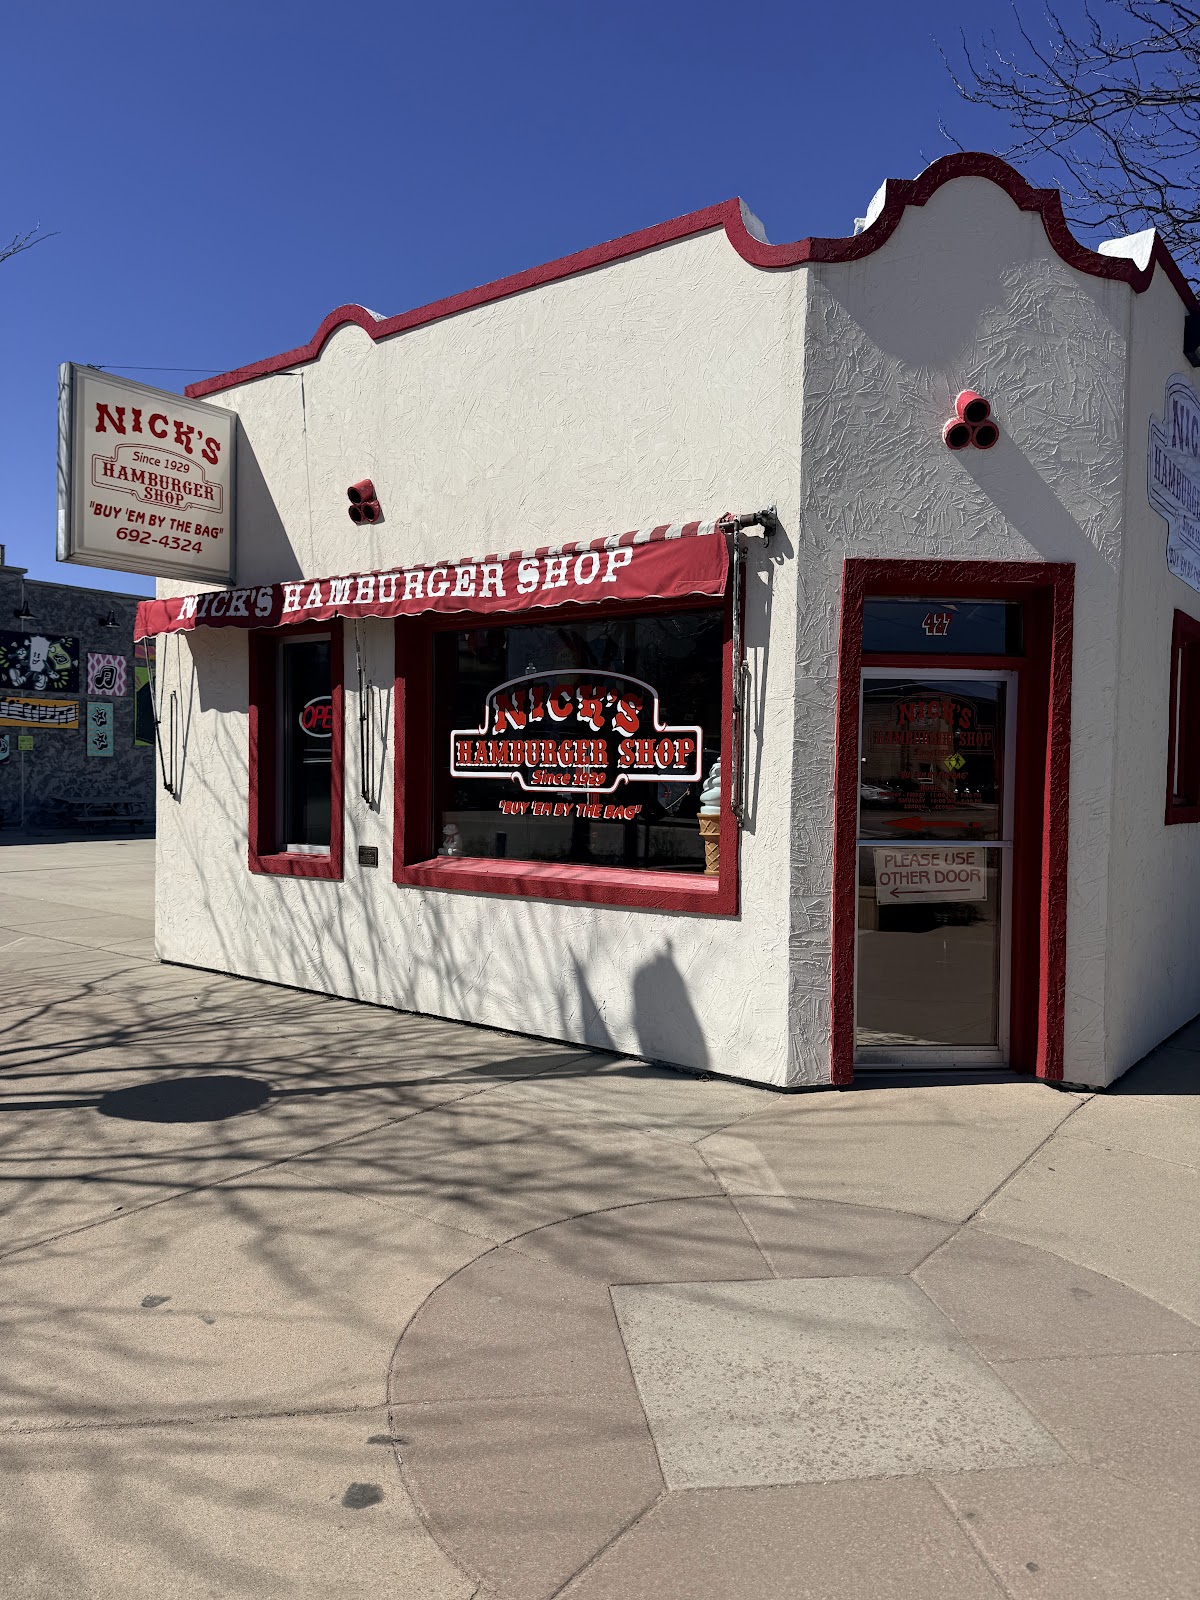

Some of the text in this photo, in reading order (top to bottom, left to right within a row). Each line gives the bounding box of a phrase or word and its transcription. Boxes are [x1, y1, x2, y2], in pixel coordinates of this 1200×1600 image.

[96, 402, 221, 465] NICK'S
[132, 451, 190, 473] Since 1929
[102, 461, 214, 501] HAMBURGER
[144, 486, 184, 505] SHOP
[90, 501, 223, 539] "BUY 'EM BY THE BAG"
[116, 527, 202, 553] 692-4324
[176, 546, 633, 621] NICK'S HAMBURGER SHOP
[921, 612, 953, 636] 427
[492, 684, 643, 738] NICK'S
[897, 701, 972, 729] NICK'S
[958, 731, 993, 747] SHOP
[456, 738, 695, 768] HAMBURGER SHOP
[530, 769, 606, 786] Since 1929
[499, 800, 530, 816] "BUY
[553, 802, 574, 817] BY
[576, 803, 603, 819] THE
[603, 805, 643, 820] BAG"
[884, 852, 975, 871] PLEASE USE
[879, 866, 982, 886] OTHER DOOR
